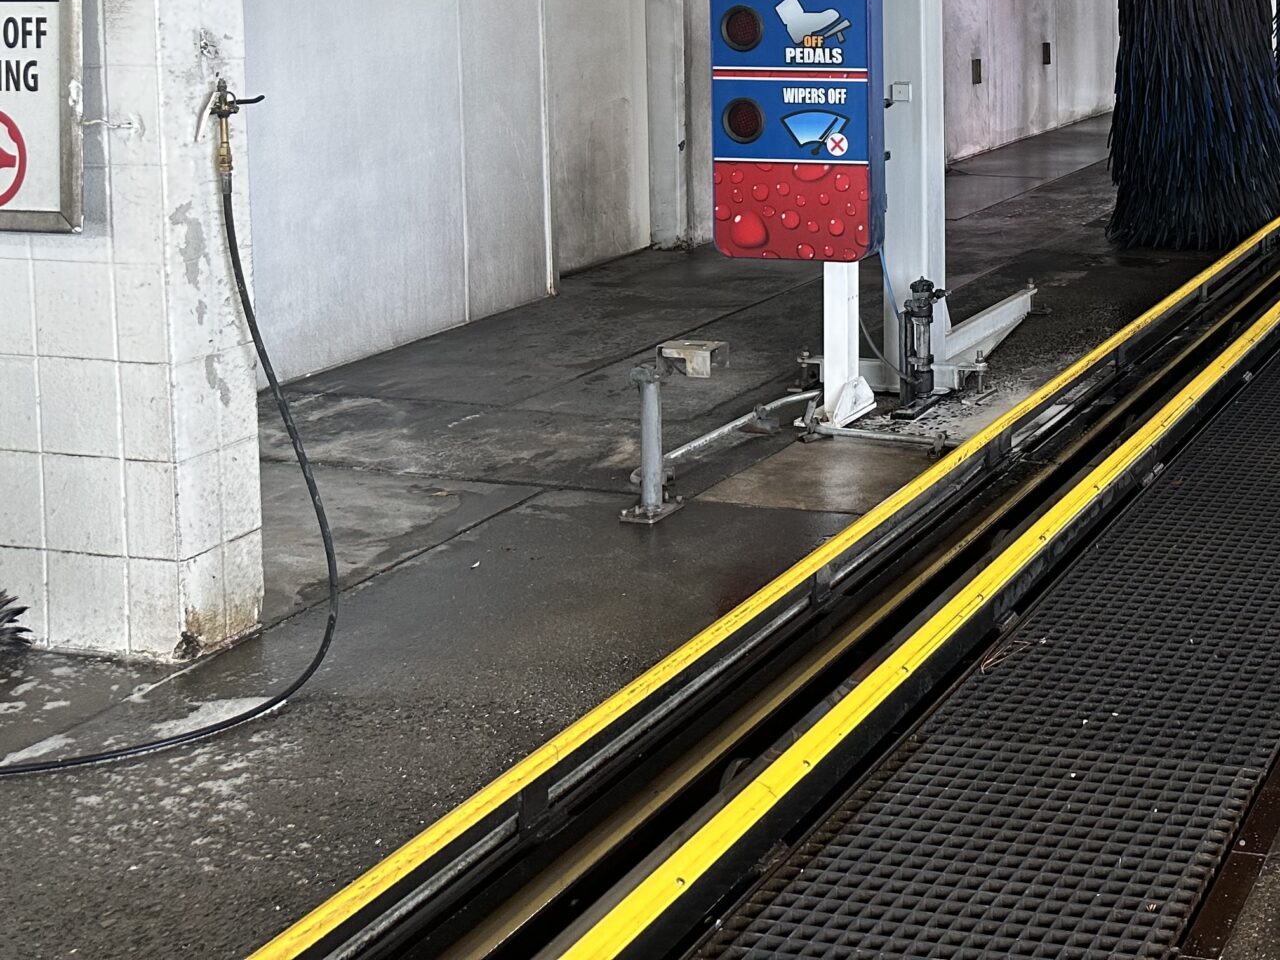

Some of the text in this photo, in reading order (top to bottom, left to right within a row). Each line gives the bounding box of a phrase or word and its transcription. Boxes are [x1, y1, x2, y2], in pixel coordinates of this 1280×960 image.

[3, 16, 47, 49] OFF
[803, 35, 824, 48] OFF
[785, 46, 843, 65] PEDALS
[783, 87, 847, 105] WIPERS OFF
